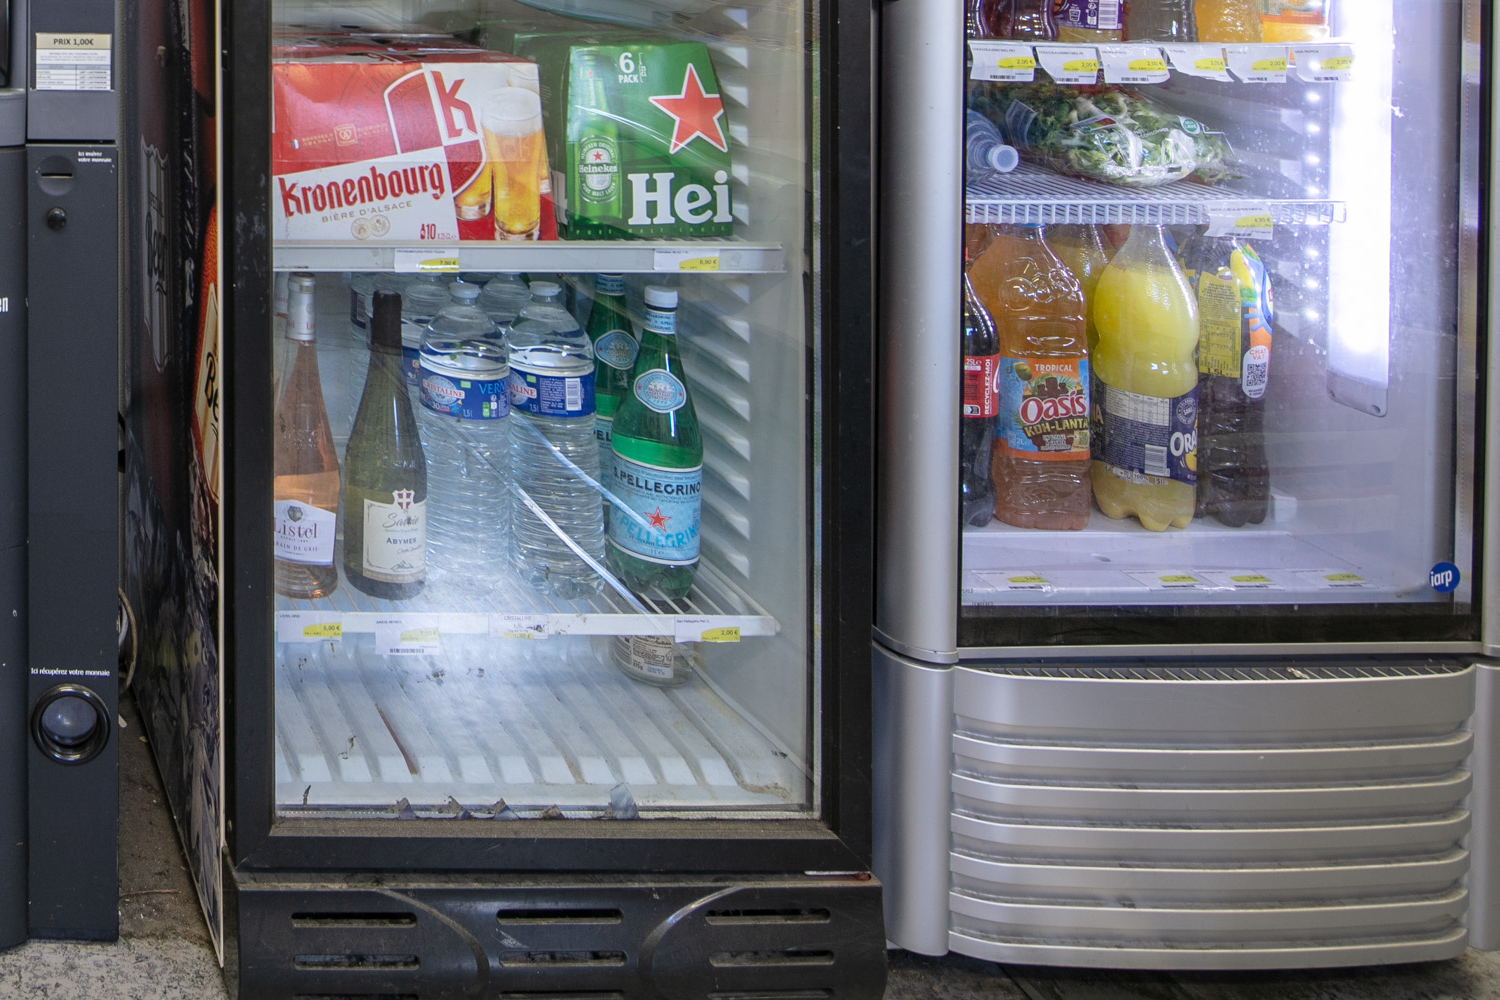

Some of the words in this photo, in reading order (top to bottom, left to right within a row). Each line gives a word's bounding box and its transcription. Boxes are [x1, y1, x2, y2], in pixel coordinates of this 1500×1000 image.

[53, 38, 71, 46] PRIX
[73, 38, 95, 46] 1,00€
[619, 52, 635, 74] 6
[618, 75, 639, 83] PACK
[578, 163, 618, 173] Heineken
[278, 162, 446, 218] Kronenbourg
[321, 209, 355, 224] BIÈRE
[359, 199, 413, 216] D'ALSACE
[426, 223, 437, 239] 10
[1034, 364, 1073, 372] TROPICAL
[422, 379, 465, 399] CRISTALINE
[1020, 390, 1087, 425] Oasis
[1024, 418, 1089, 437] KOH-LANTA
[275, 542, 291, 550] RAIN
[386, 537, 417, 545] ABYMES
[1430, 569, 1453, 588] iarp
[39, 667, 67, 676] récupérez
